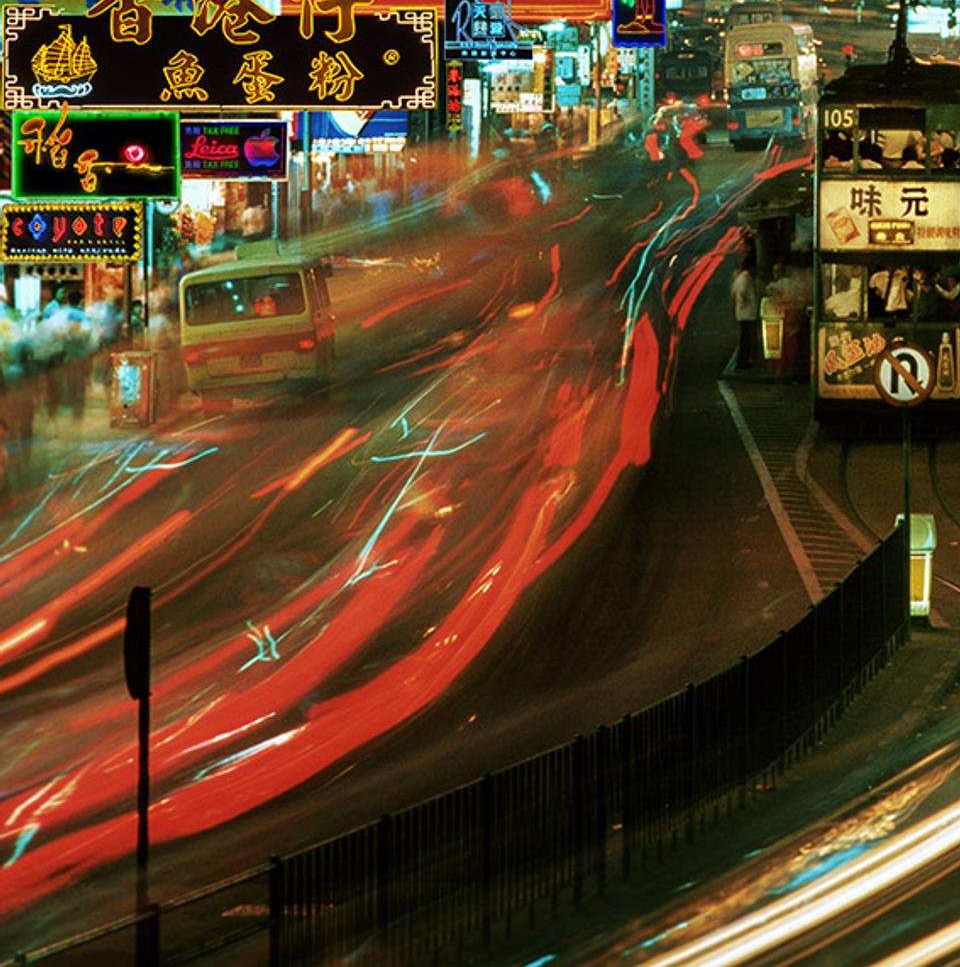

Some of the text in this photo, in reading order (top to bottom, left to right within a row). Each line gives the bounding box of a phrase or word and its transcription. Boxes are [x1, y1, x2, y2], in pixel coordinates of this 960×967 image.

[159, 49, 366, 103] 魚蛋粉
[823, 108, 854, 129] 105
[185, 134, 240, 161] Leica
